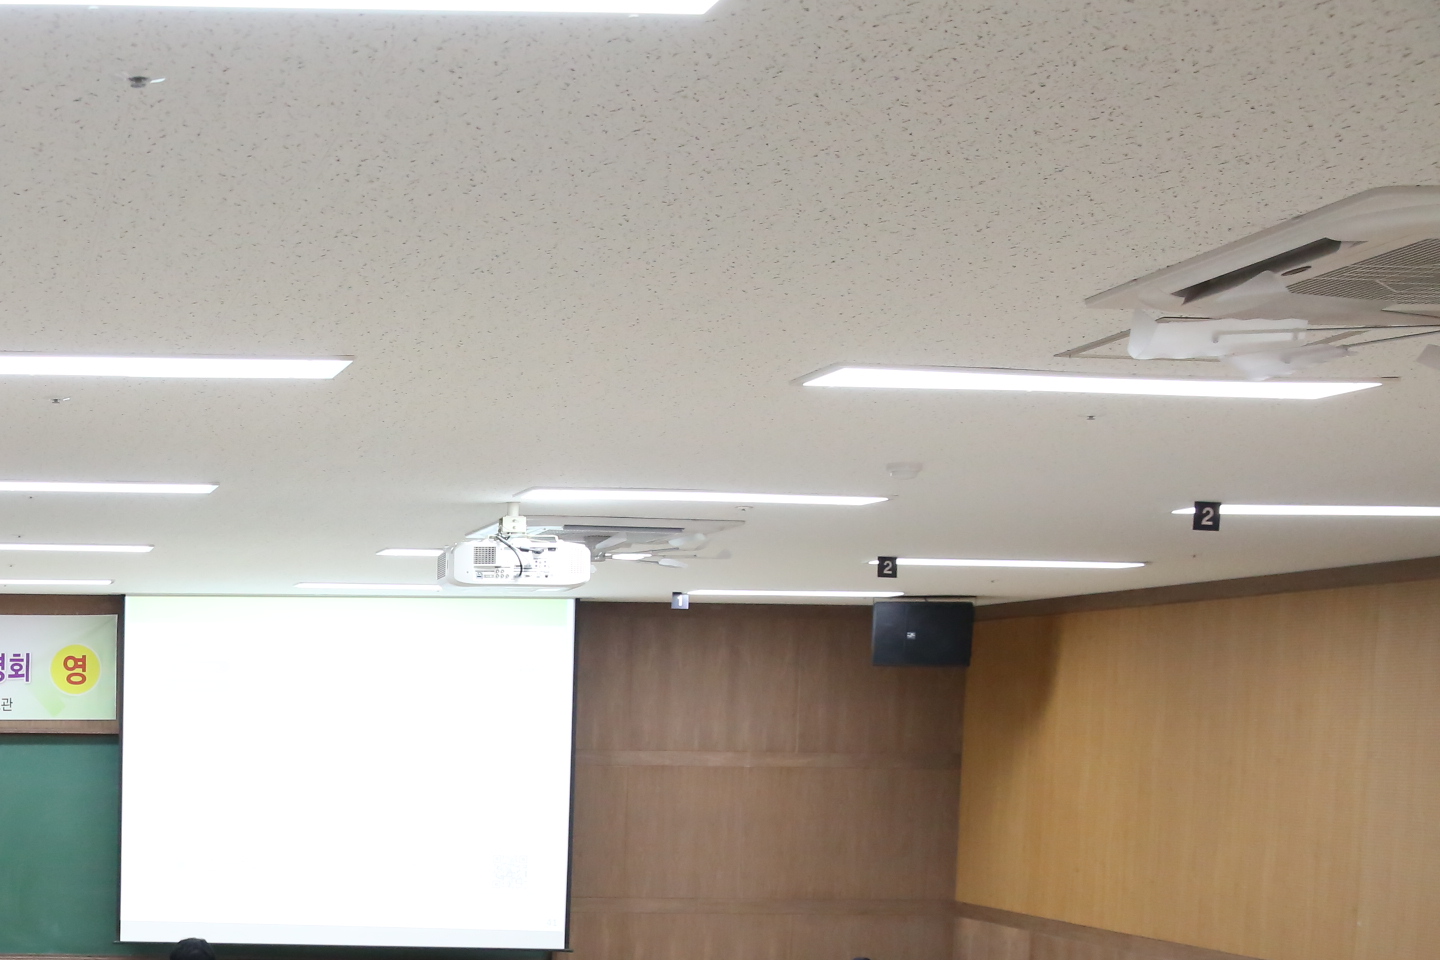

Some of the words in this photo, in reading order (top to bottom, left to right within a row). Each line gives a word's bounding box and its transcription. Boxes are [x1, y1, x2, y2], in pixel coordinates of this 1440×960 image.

[1201, 506, 1215, 526] 2
[883, 560, 893, 574] 2
[677, 595, 683, 607] 1
[62, 654, 87, 686] 영
